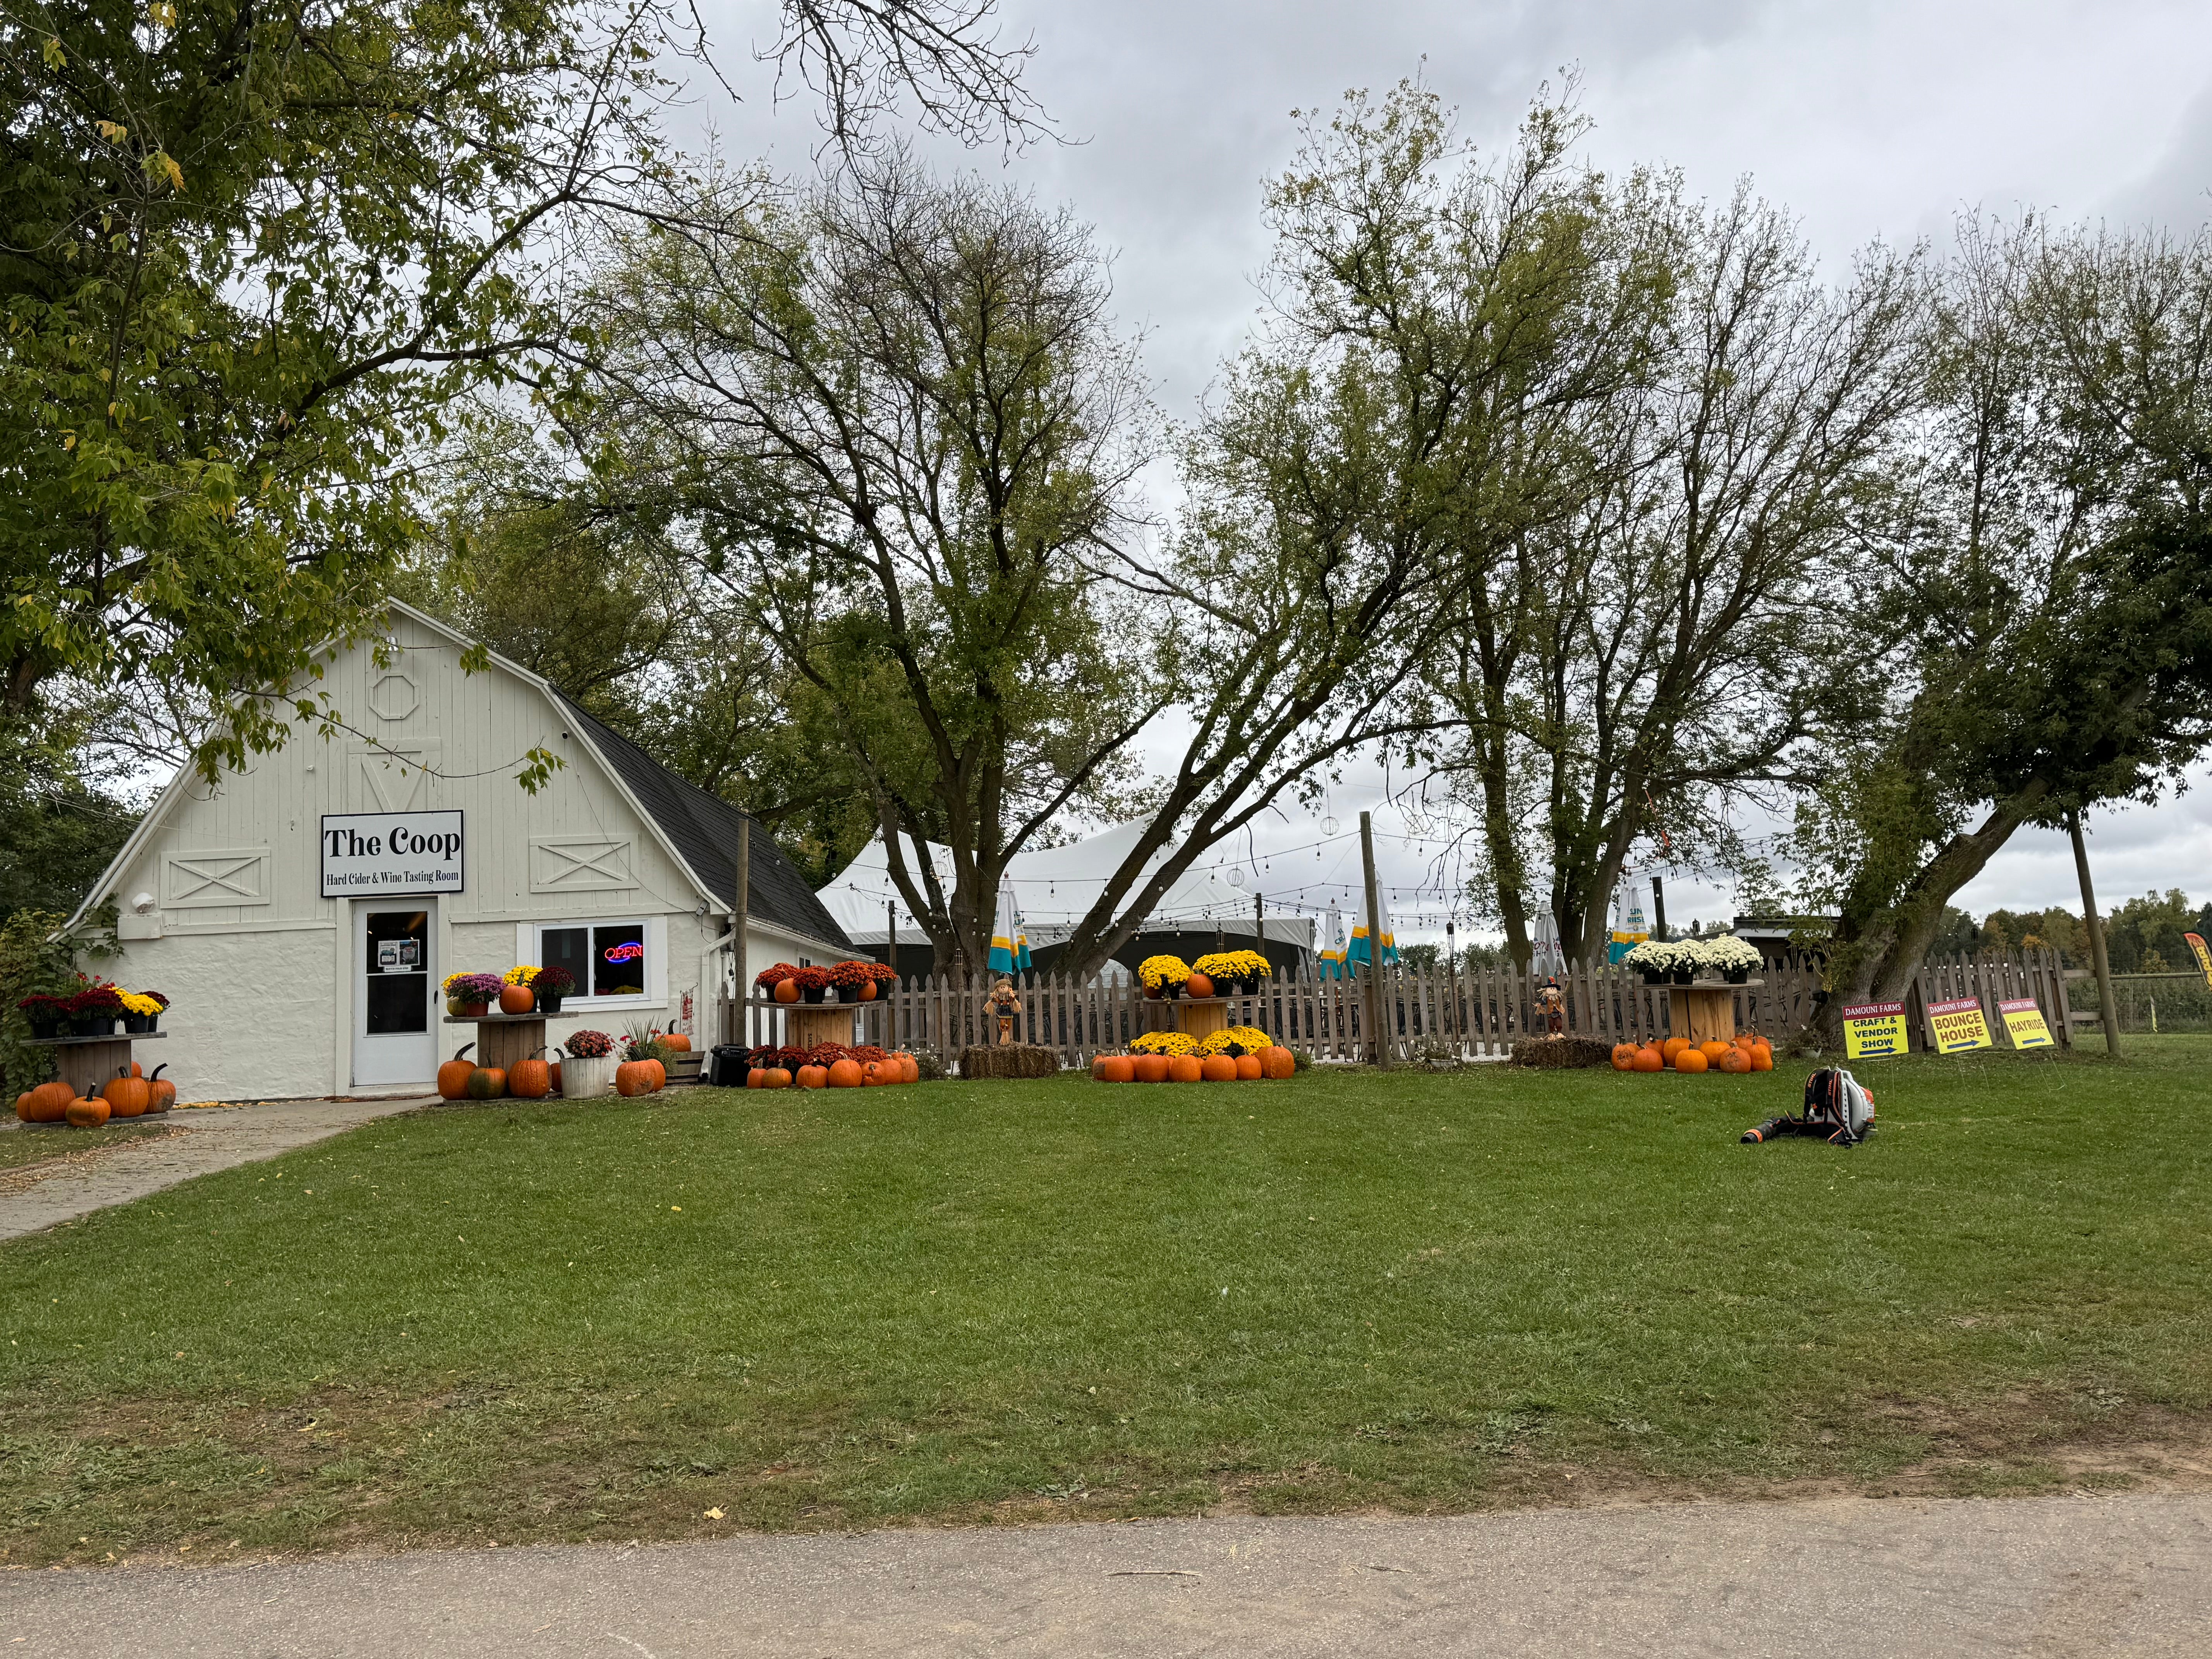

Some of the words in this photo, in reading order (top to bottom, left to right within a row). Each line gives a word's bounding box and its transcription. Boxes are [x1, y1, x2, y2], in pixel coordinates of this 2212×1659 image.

[325, 828, 381, 857] The
[389, 827, 460, 860] Coop
[326, 873, 347, 885] Hard
[349, 872, 370, 884] Cider
[372, 872, 378, 884] &
[380, 871, 402, 883] Wine
[404, 870, 434, 884] Tasting
[436, 870, 459, 881] Room
[605, 945, 642, 959] OPEN
[1845, 1006, 1878, 1016] DAMOUNI
[1880, 1003, 1901, 1012] FARMS
[1929, 1003, 1956, 1014] DAMOUNI
[1957, 1000, 1977, 1009] FARMS
[1853, 1018, 1886, 1027] CRAFT
[1934, 1012, 1981, 1030] BOUNCE
[2009, 1019, 2045, 1033] HAYRIDE
[1854, 1027, 1898, 1038] VENDOR
[1940, 1026, 1984, 1042] HOUSE
[1861, 1038, 1893, 1048] SHOW
[1808, 1073, 1816, 1088] STIHL
